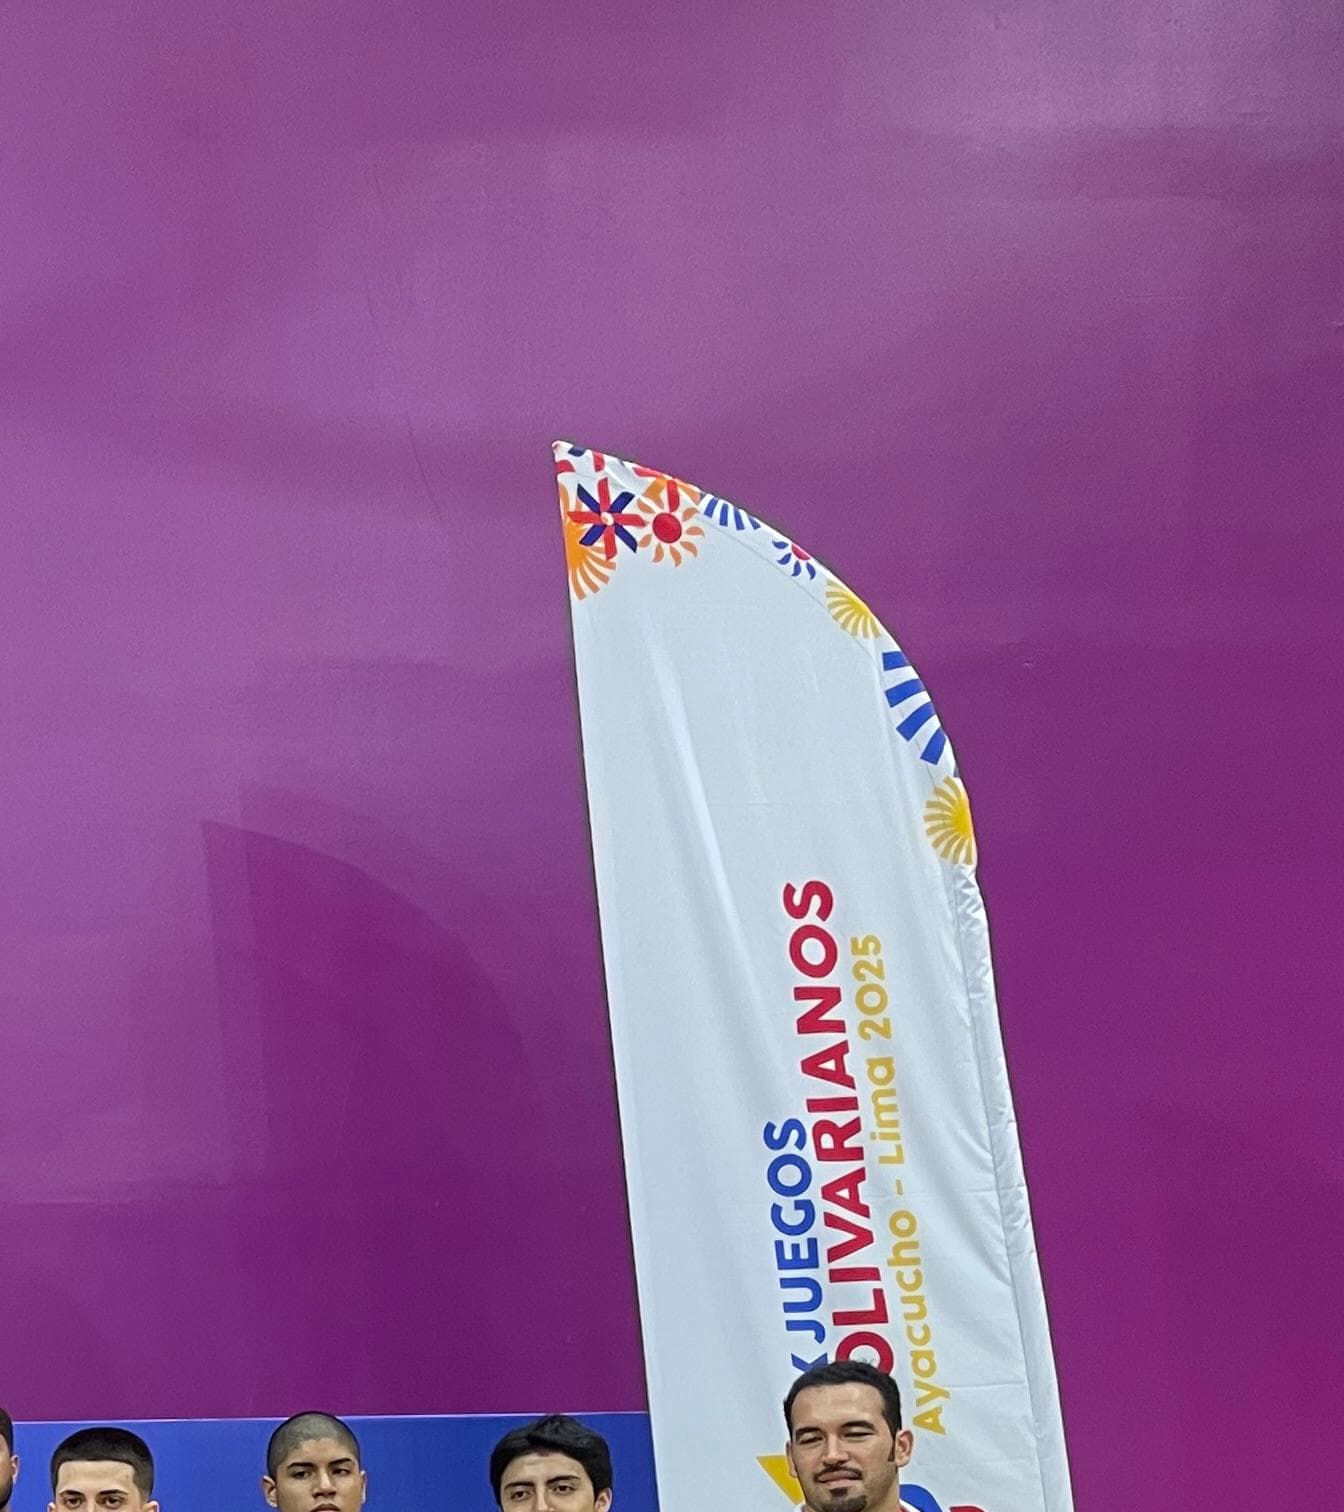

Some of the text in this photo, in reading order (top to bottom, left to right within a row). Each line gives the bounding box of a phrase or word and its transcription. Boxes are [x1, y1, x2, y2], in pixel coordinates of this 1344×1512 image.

[850, 935, 892, 1041] 2025
[783, 880, 895, 1374] OLIVARIANOS
[866, 1057, 904, 1165] Lima
[764, 1118, 824, 1343] JUEGOS
[887, 1210, 951, 1435] Ayacucho
